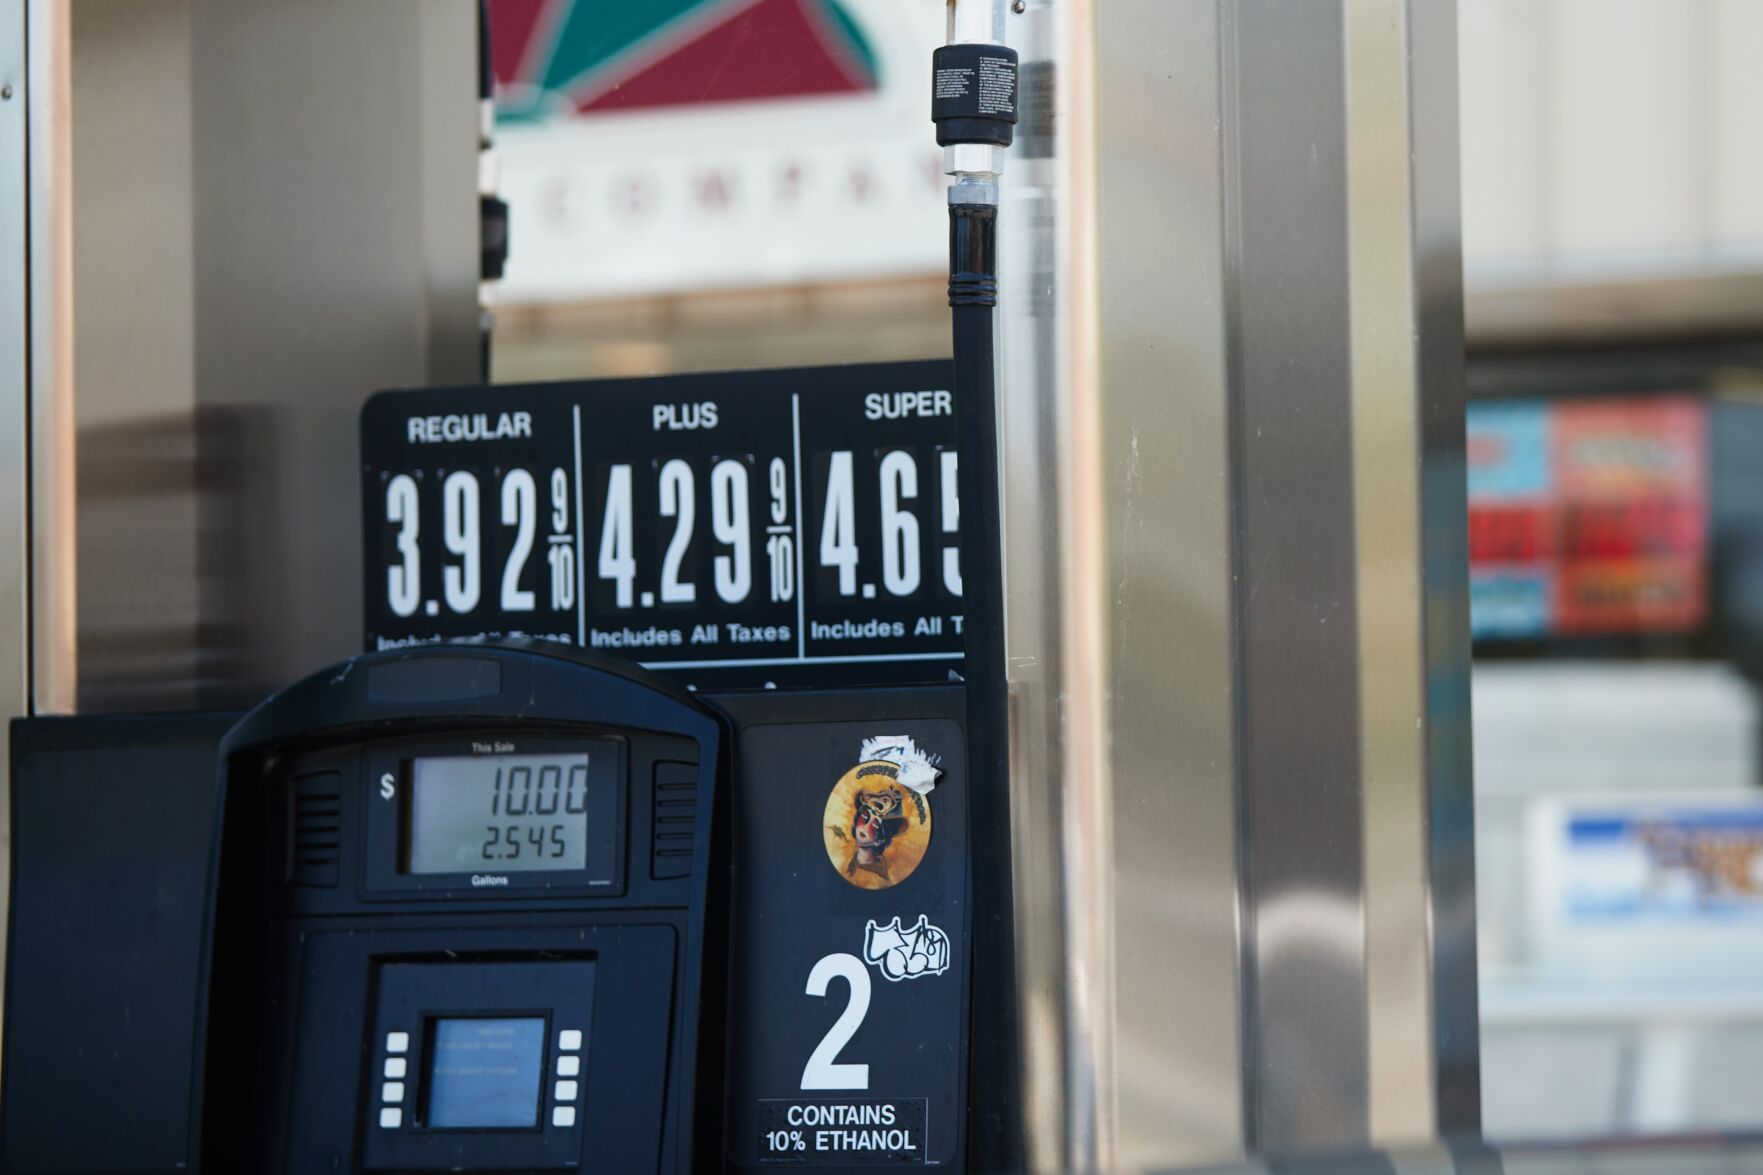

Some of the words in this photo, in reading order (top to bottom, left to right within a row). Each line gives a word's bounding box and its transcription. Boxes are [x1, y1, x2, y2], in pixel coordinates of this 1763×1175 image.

[652, 401, 719, 431] PLUS
[864, 390, 952, 420] SUPER
[407, 411, 532, 443] REGULAR
[386, 468, 537, 617] 3.92
[598, 457, 752, 608] 4.29
[590, 626, 683, 648] Includes
[690, 624, 719, 644] All
[726, 623, 791, 643] Taxes
[810, 618, 905, 640] Includes
[913, 616, 942, 636] All
[471, 742, 492, 754] This
[494, 741, 515, 753] Sale
[380, 772, 396, 801] $
[491, 763, 588, 816] 10.00
[481, 825, 566, 860] 2.545
[471, 875, 509, 887] Gallons
[800, 952, 872, 1091] 2
[787, 1104, 896, 1127] CONTAINS
[765, 1130, 807, 1152] 10%
[815, 1129, 917, 1152] ETHANOL
